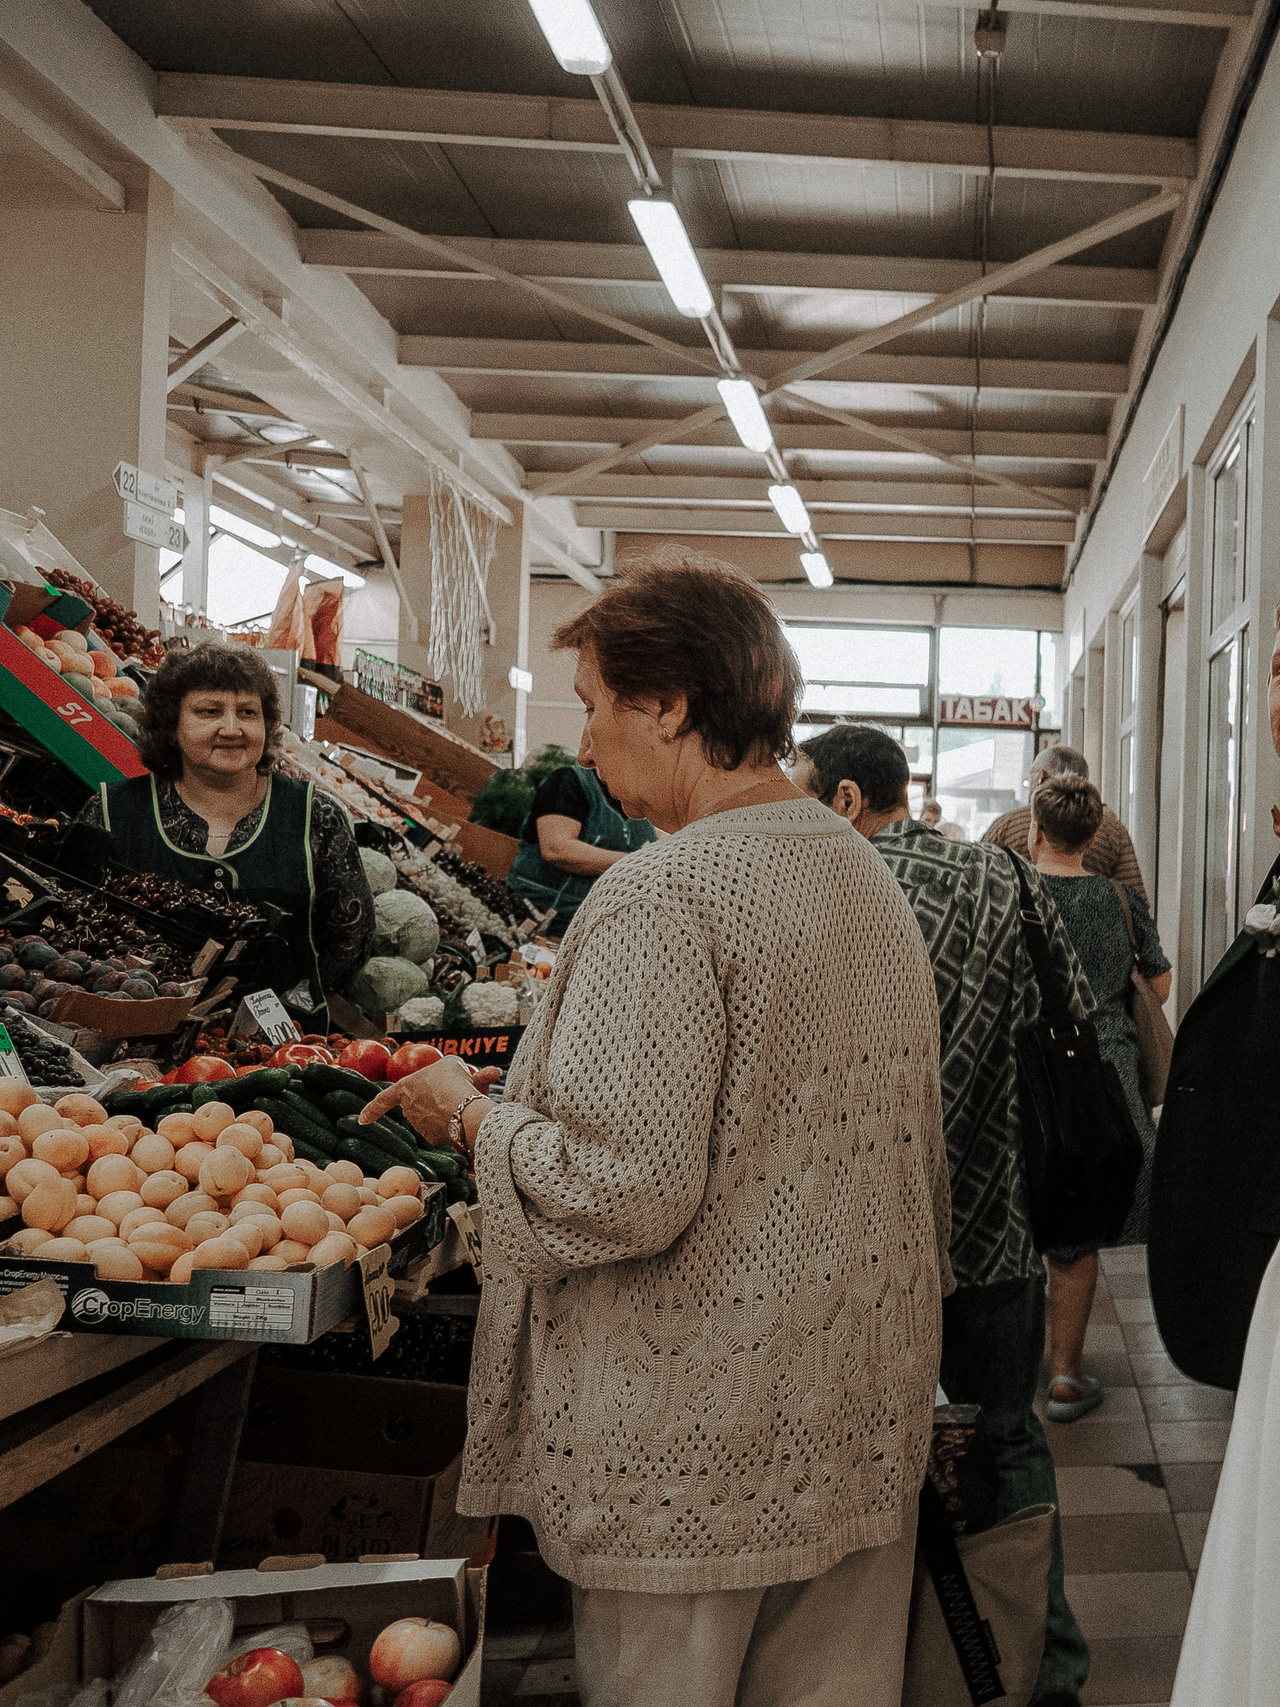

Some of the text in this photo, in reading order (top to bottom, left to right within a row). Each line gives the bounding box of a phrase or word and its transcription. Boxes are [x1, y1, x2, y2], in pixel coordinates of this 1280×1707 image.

[123, 470, 136, 495] 22
[168, 526, 181, 548] 23
[57, 702, 93, 725] 57
[940, 696, 1031, 724] ТАБАК
[418, 1036, 509, 1056] ÜRKIYE
[82, 1296, 206, 1325] CropEnergy
